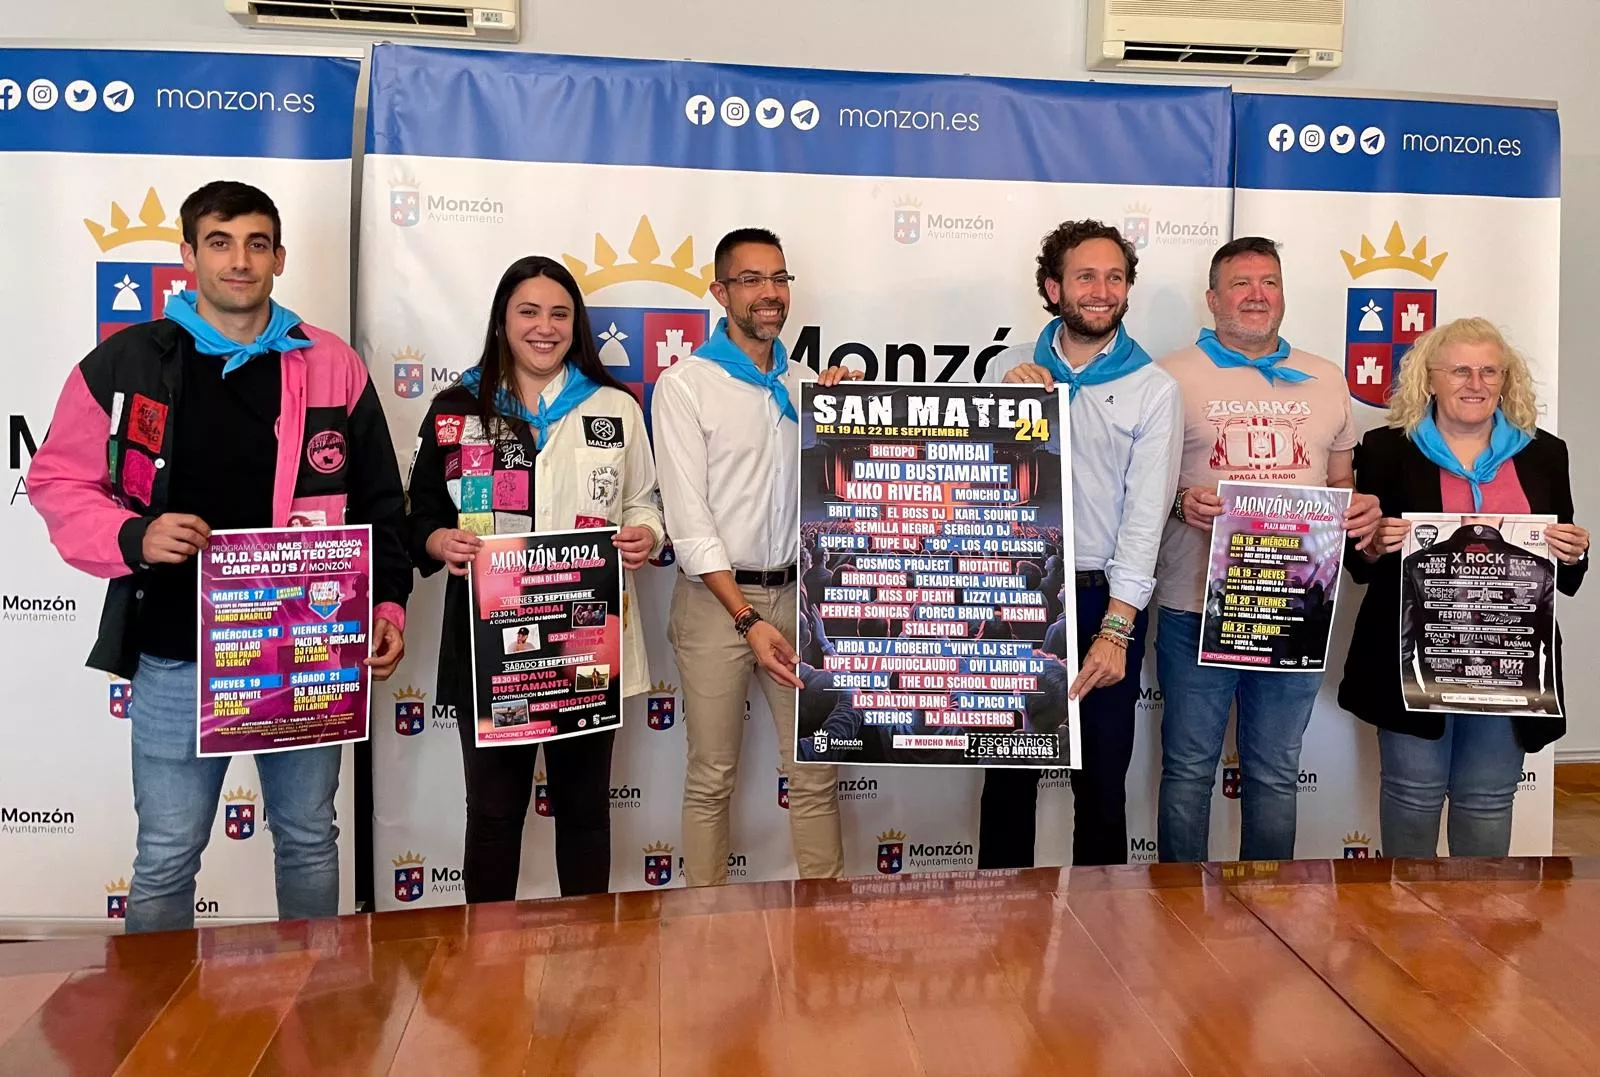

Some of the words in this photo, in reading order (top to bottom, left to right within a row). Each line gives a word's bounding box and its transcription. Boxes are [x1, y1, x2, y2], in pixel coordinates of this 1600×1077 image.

[156, 88, 315, 112] monzon.es
[839, 107, 980, 132] monzon.es
[1403, 132, 1521, 157] monzon.es
[427, 195, 504, 214] Monzón
[428, 212, 504, 224] Ayuntamiento
[928, 215, 994, 230] Monzón
[928, 229, 994, 240] Ayuntamiento
[1156, 221, 1219, 236] Monzón
[1156, 236, 1218, 247] Ayuntamiento
[813, 395, 893, 425] SAN
[907, 394, 1043, 429] MATEO
[1205, 400, 1312, 417] ZIGARROS
[816, 425, 836, 434] DEL
[838, 426, 851, 434] 19
[853, 426, 866, 435] AL
[868, 427, 882, 435] 22
[885, 427, 898, 436] DE
[901, 428, 969, 437] SEPTIEMBRE
[1015, 418, 1049, 441] 24
[587, 439, 623, 448] MALLAZO
[872, 446, 915, 457] BIGTOPO
[927, 444, 990, 461] BOMBAI
[854, 463, 900, 480] DAVID
[906, 465, 1008, 482] BUSTAMANTE
[847, 483, 882, 500] KIKO
[887, 485, 942, 502] RIVERA
[955, 489, 1000, 501] MONCHO
[1003, 490, 1017, 501] DJ
[1235, 495, 1292, 515] MONZÓN
[1296, 501, 1331, 516] 2024
[829, 507, 850, 517] BRIT
[855, 507, 878, 518] HITS
[887, 508, 899, 518] EL
[902, 509, 929, 519] BOSS
[932, 509, 945, 519] DJ
[955, 510, 980, 520] KARL
[984, 510, 1018, 521] SOUND
[1021, 511, 1035, 521] DJ
[854, 522, 898, 533] SEMILLA
[902, 524, 935, 534] NEGRA
[944, 525, 993, 535] SERGIOLO
[996, 525, 1010, 536] DJ
[212, 552, 251, 565] M.Q.D.
[254, 551, 281, 562] SAN
[282, 549, 325, 561] MATEO
[328, 547, 360, 558] 2024
[491, 544, 557, 572] MONZÓN
[561, 545, 599, 566] 2024
[1452, 553, 1460, 563] X
[1466, 553, 1504, 564] ROCK
[222, 564, 270, 575] CARPA
[272, 562, 297, 574] DJ'S
[300, 561, 305, 572] /
[309, 560, 351, 571] MONZÓN
[857, 558, 901, 570] COSMOS
[904, 559, 949, 571] PROJECT
[959, 560, 1010, 572] RIOTATTIC
[1451, 564, 1505, 575] MONZÓN
[1228, 566, 1240, 577] DÍA
[1242, 569, 1250, 577] 19
[1258, 569, 1285, 579] JUEVES
[521, 576, 544, 584] AVENIDA
[546, 575, 553, 583] DE
[842, 575, 906, 586] BIRROLOGOS
[916, 575, 979, 587] DEKADENCIA
[982, 576, 1025, 588] JUVENIL
[212, 591, 249, 601] MARTES
[254, 591, 264, 599] 17
[502, 597, 532, 605] VIERNES
[545, 591, 592, 602] SEPTIEMBRE
[824, 589, 869, 600] FESTOPA
[879, 590, 903, 601] KISS
[906, 590, 918, 601] OF
[921, 591, 954, 602] DEATH
[963, 591, 991, 603] LIZZY
[995, 592, 1006, 603] LA
[1010, 592, 1041, 604] LARGA
[1225, 594, 1237, 605] DÍA
[1258, 598, 1286, 607] VIERNES
[2, 596, 76, 610] Monzón
[518, 604, 563, 615] BOMBAI
[3, 612, 76, 622] Ayuntamiento
[822, 605, 861, 617] PERVER
[865, 606, 910, 618] SONICAS
[919, 607, 955, 619] PORCO
[958, 607, 993, 619] BRAVO
[1003, 609, 1045, 620] RASMIA
[1439, 611, 1471, 619] FESTOPA
[213, 629, 263, 639] MIÉRCOLES
[268, 628, 278, 636] 18
[293, 625, 327, 635] VIERNES
[905, 623, 964, 636] STALENTAO
[1222, 621, 1234, 632] DÍA
[1253, 623, 1280, 634] SÁBADO
[215, 642, 239, 651] JORDI
[240, 641, 260, 650] LARO
[505, 662, 536, 671] SÁBADO
[547, 655, 593, 666] SEPTIEMBRE
[212, 680, 245, 689] JUEVES
[250, 679, 260, 687] 19
[292, 673, 324, 684] SÁBADO
[330, 672, 339, 680] 21
[215, 692, 237, 700] APOLO
[239, 691, 261, 699] WHITE
[294, 687, 305, 696] DJ
[308, 683, 360, 695] BALLESTEROS
[558, 694, 605, 707] BIGTOPO
[854, 695, 873, 707] LOS
[877, 695, 917, 707] DALTON
[920, 696, 947, 708] BANG
[960, 696, 974, 708] DJ
[978, 697, 1004, 708] PACO
[1008, 697, 1024, 708] PIL
[865, 711, 912, 724] STRENOS
[926, 712, 939, 724] DJ
[943, 713, 1013, 725] BALLESTEROS
[831, 737, 863, 747] Monzón
[914, 738, 946, 747] MUCHO
[949, 736, 965, 747] MÁS!
[971, 737, 976, 746] 7
[979, 737, 1052, 747] ESCENARIOS
[996, 747, 1009, 755] 60
[1012, 747, 1053, 756] ARTISTAS
[834, 777, 878, 792] nzón
[1, 808, 74, 823] Monzón
[2, 825, 74, 835] Ayuntamiento
[909, 842, 973, 857] Monzón
[909, 856, 974, 867] Ayuntamiento
